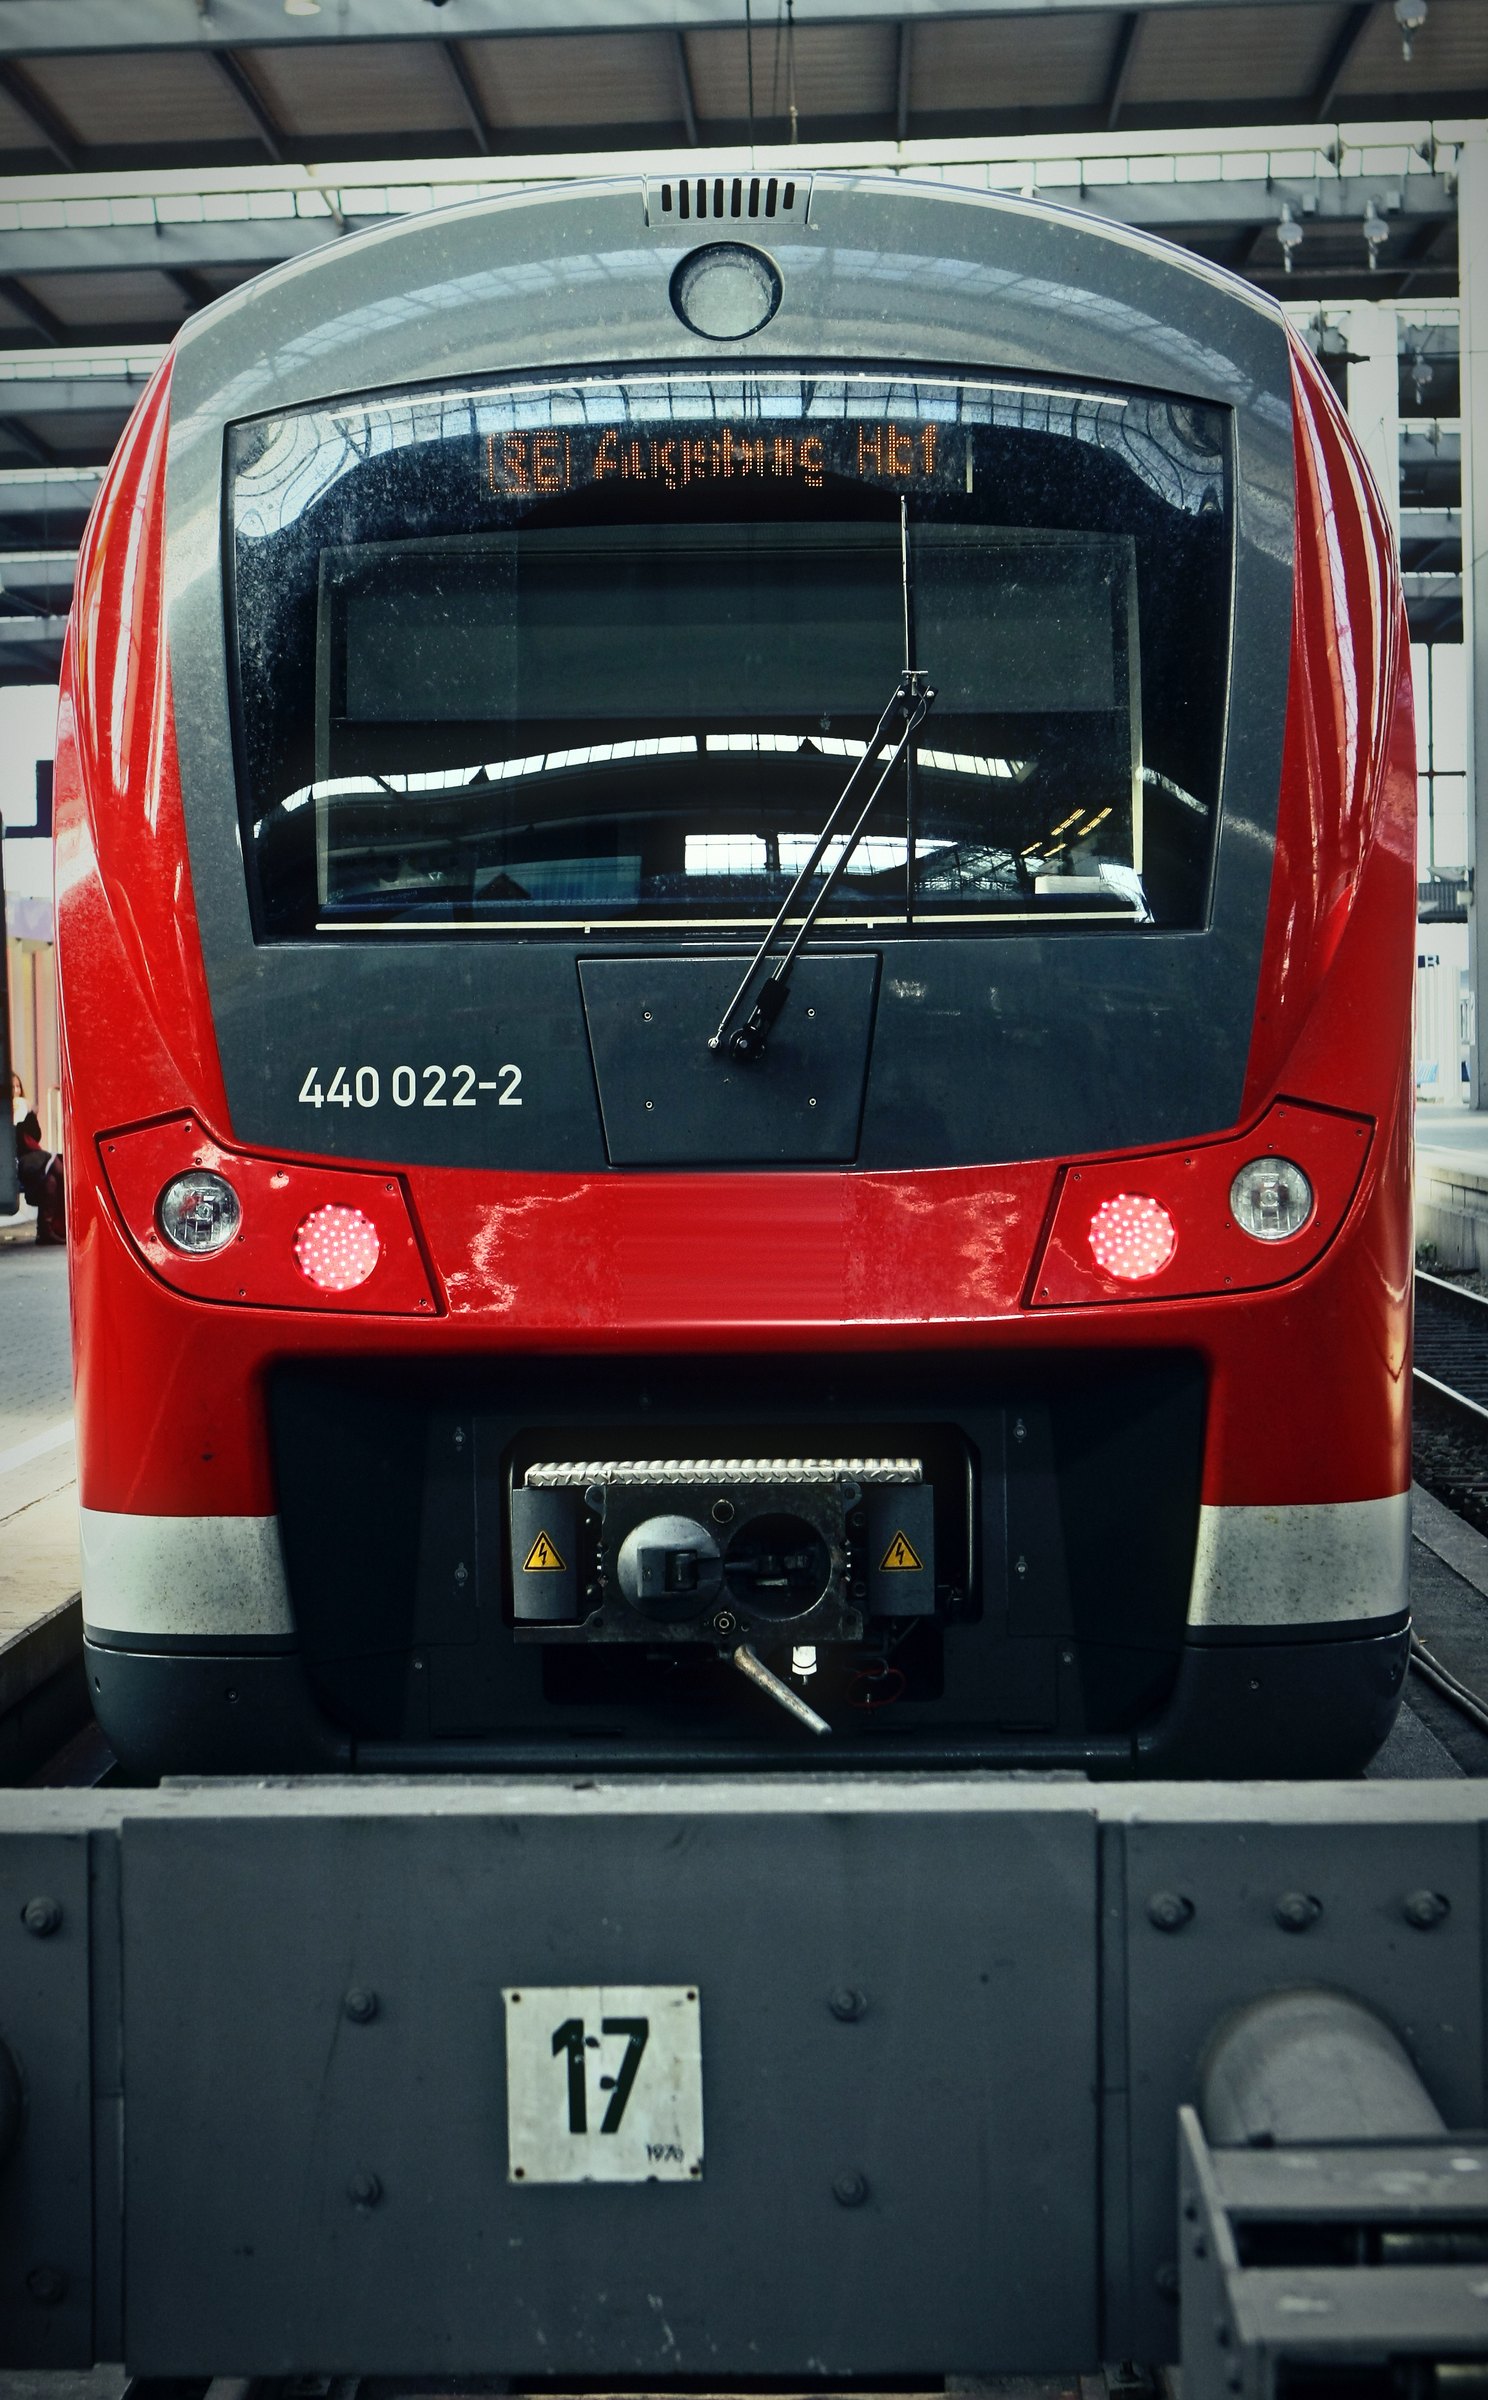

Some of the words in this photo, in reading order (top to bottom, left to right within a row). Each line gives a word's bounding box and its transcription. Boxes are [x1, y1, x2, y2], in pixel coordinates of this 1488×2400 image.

[500, 436, 561, 485] RE
[858, 424, 938, 476] Hbf
[298, 1065, 380, 1108] 440
[392, 1064, 523, 1107] 022-2
[552, 2017, 650, 2135] 17
